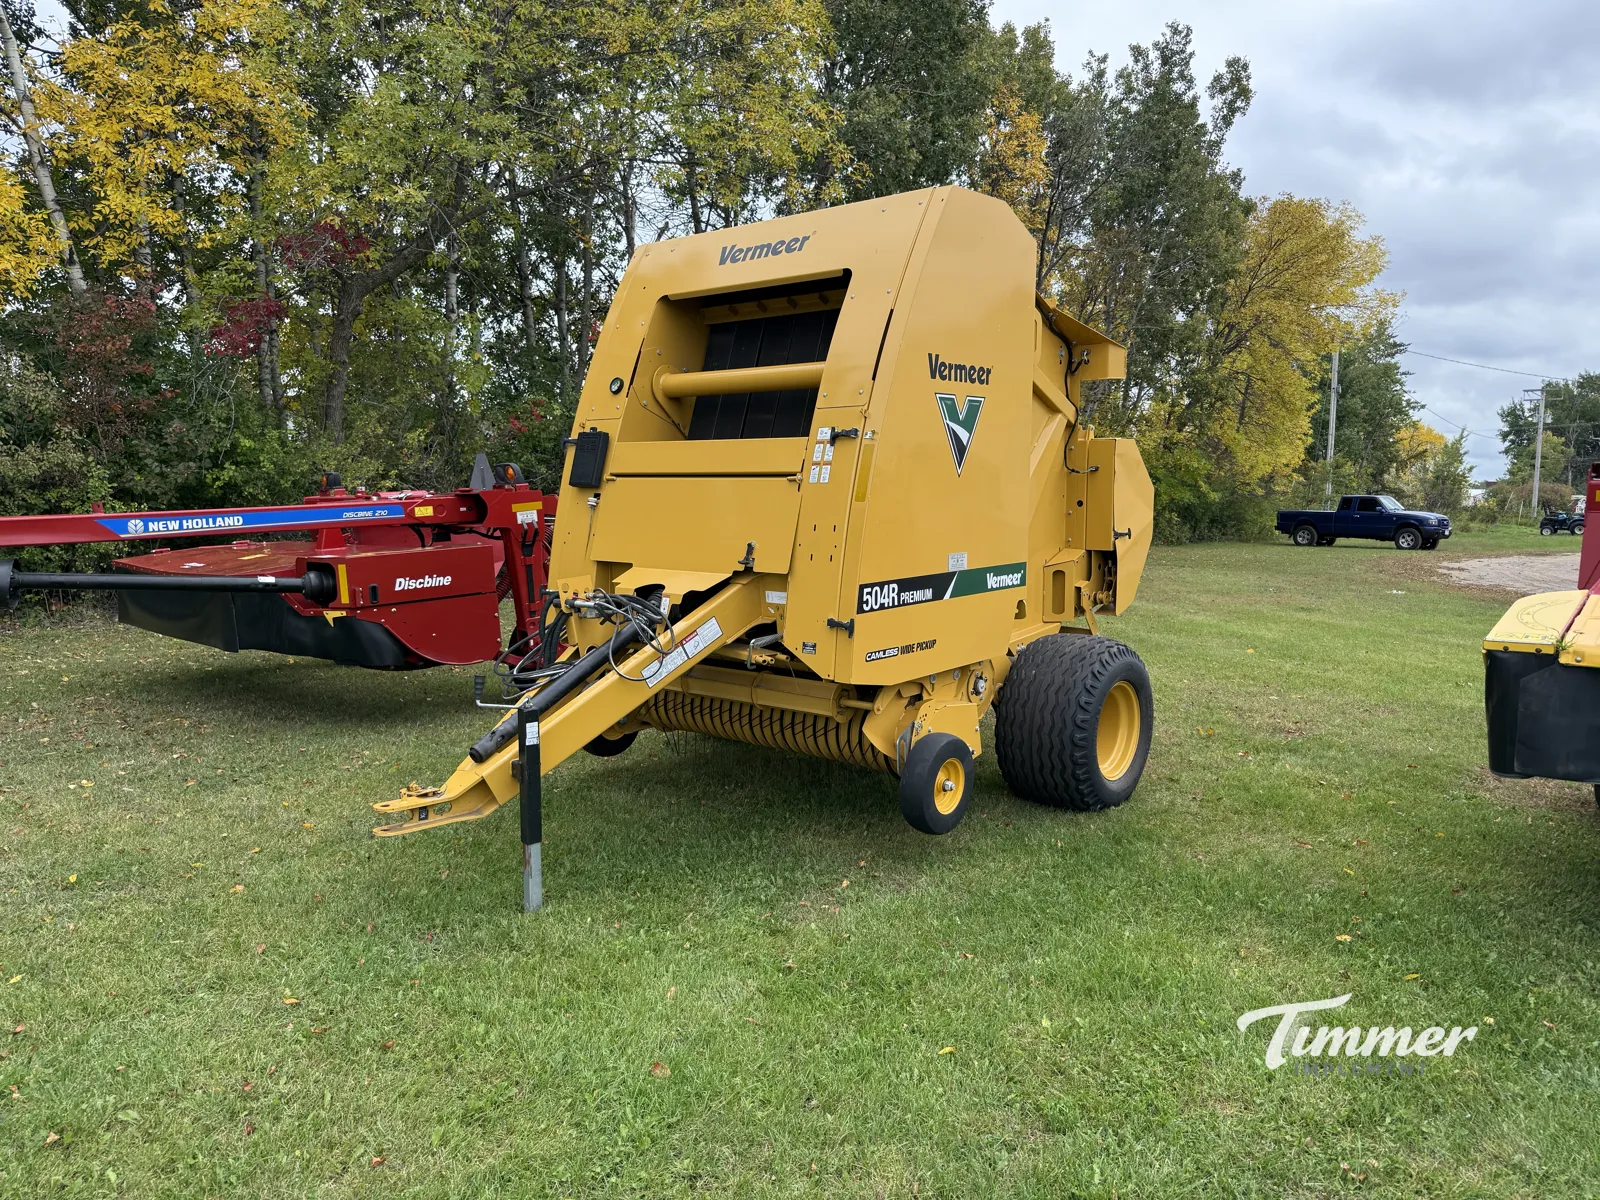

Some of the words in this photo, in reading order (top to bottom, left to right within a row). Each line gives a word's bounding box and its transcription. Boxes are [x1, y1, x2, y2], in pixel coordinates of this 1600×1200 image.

[719, 234, 812, 266] Vermeer
[927, 352, 992, 386] Vermeer
[148, 520, 180, 532] NEW
[182, 516, 244, 529] HOLLAND
[394, 574, 452, 591] Discbine
[986, 571, 1023, 589] Vermeer
[862, 583, 899, 611] 504R
[900, 588, 933, 604] PREMIUM
[865, 648, 899, 661] CAMLESS
[900, 643, 916, 655] WIDE
[916, 639, 937, 652] PICKUP
